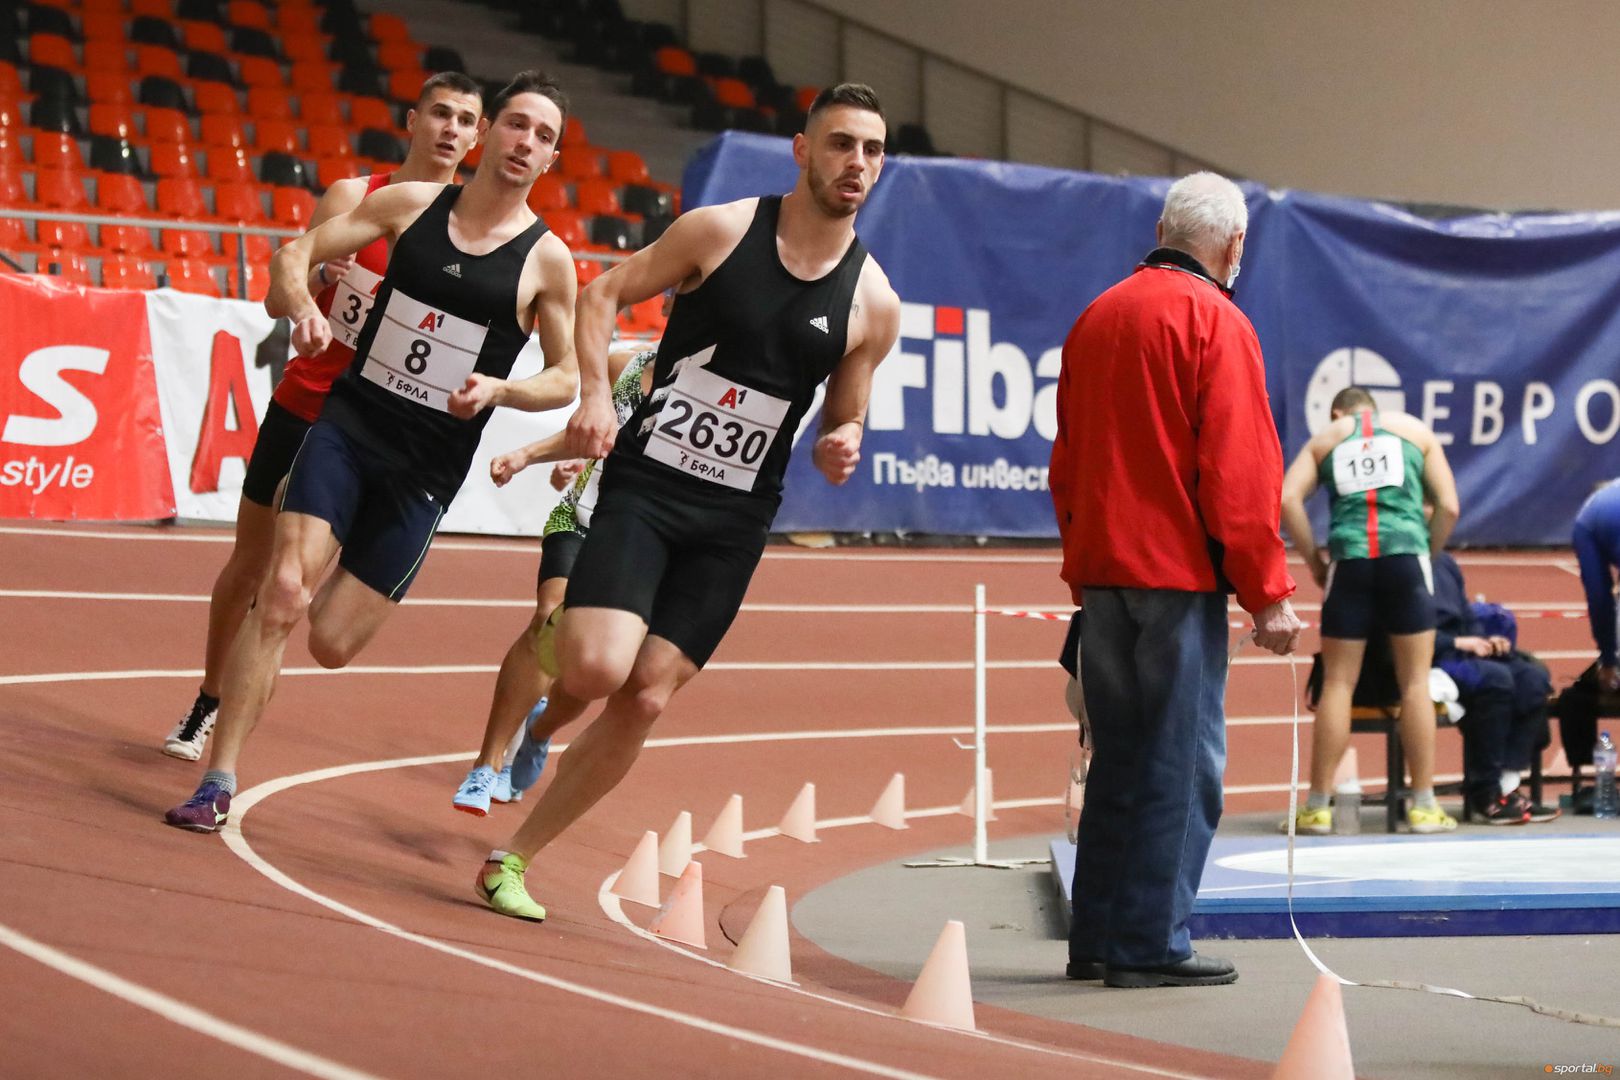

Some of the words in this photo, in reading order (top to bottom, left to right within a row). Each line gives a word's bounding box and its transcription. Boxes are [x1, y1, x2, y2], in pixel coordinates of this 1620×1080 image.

[418, 311, 445, 333] A1
[404, 339, 431, 375] 8
[396, 379, 429, 402] БФЛА
[717, 387, 748, 410] A1
[658, 399, 768, 465] 2630
[0, 455, 94, 495] style
[690, 460, 726, 481] БФЛА
[873, 453, 955, 493] Първа
[1347, 454, 1388, 478] 191
